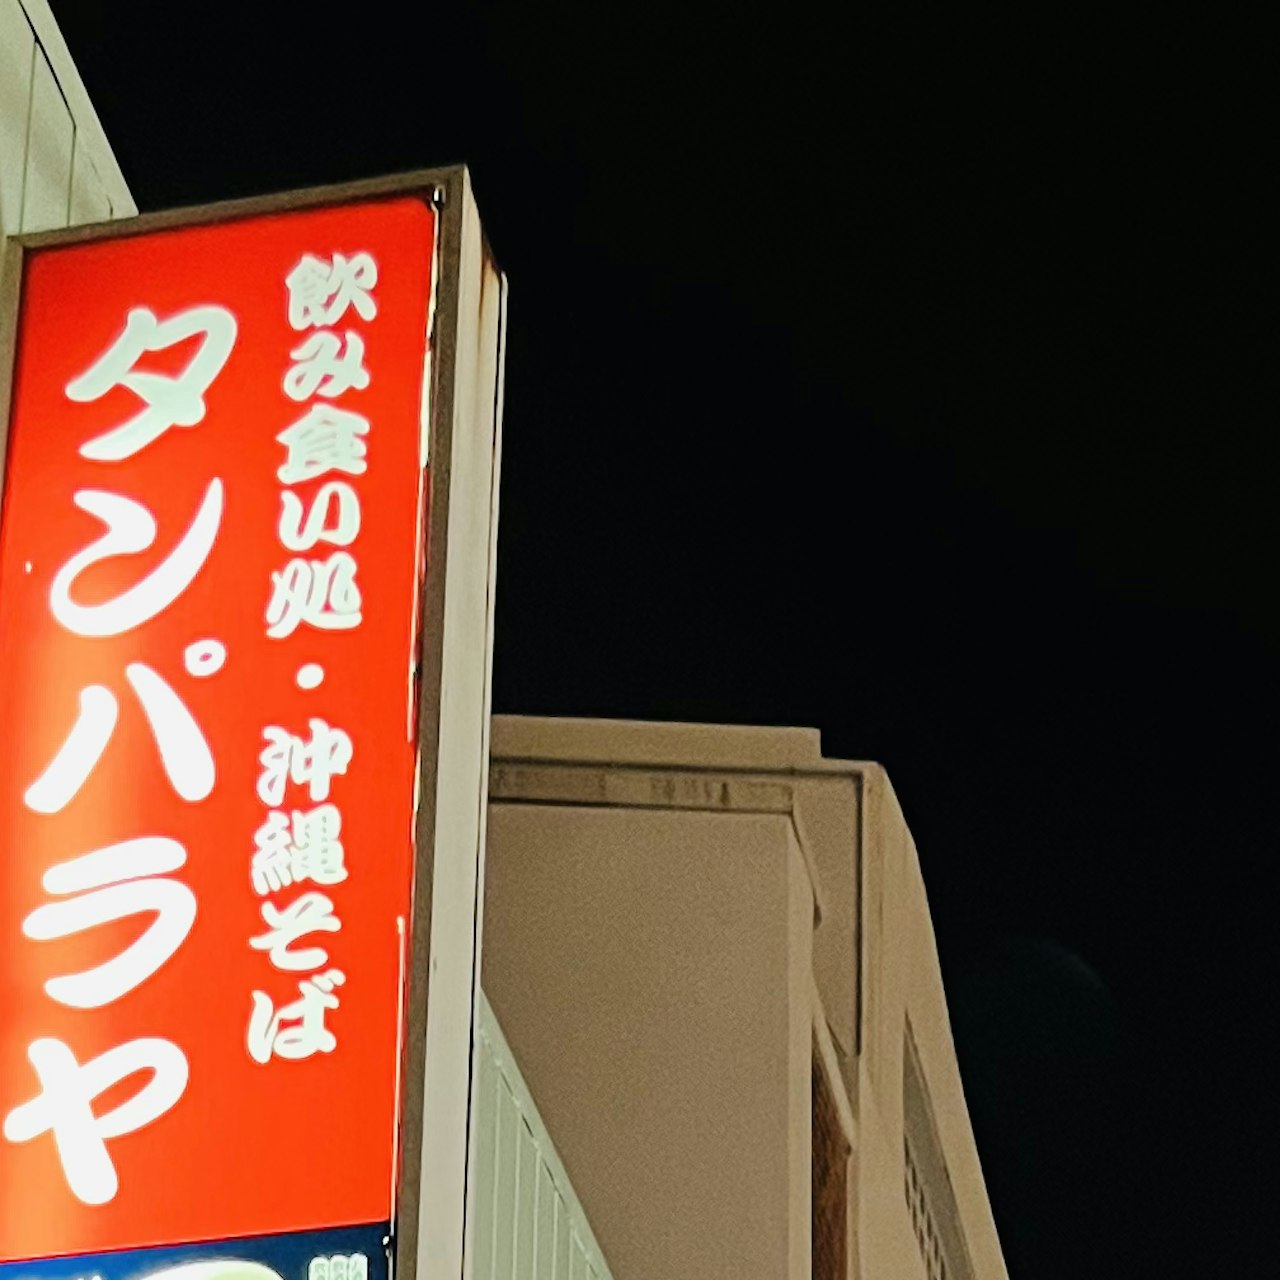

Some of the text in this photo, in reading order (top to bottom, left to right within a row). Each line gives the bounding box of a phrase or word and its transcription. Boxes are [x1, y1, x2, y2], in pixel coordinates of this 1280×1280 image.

[3, 304, 238, 1205] タンパラヤ
[246, 252, 378, 1063] 飲み食い処・沖縄そば
